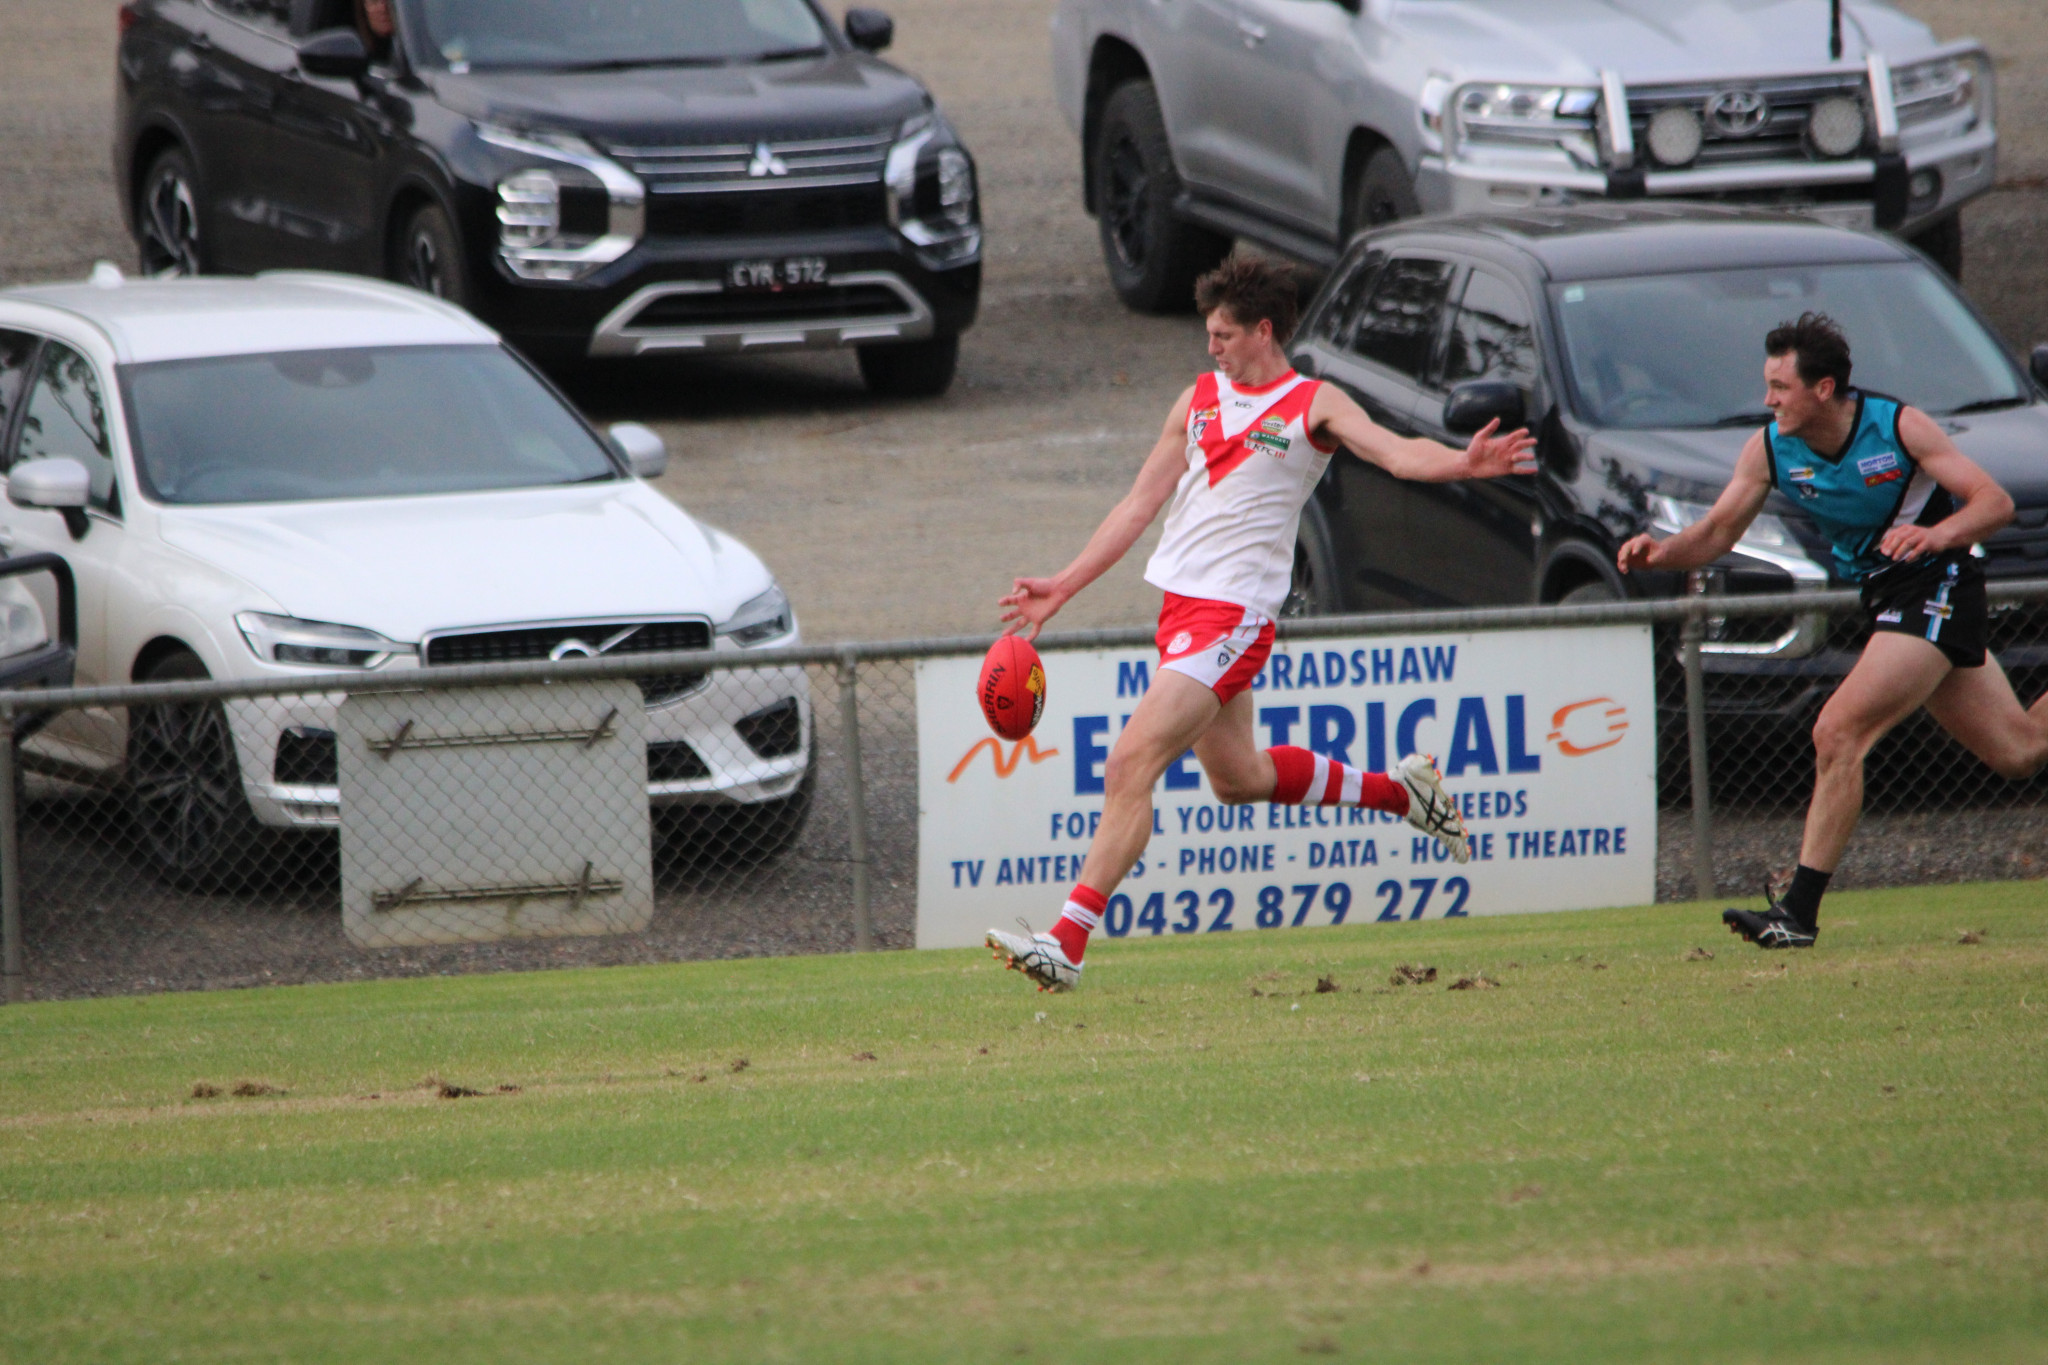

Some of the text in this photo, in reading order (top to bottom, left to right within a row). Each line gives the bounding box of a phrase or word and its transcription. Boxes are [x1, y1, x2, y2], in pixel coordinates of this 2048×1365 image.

[1073, 694, 1541, 796] ETRICAL
[1177, 803, 1255, 834] YOUR
[1268, 802, 1404, 829] ELECTRIC
[951, 859, 985, 888] TV
[995, 852, 1146, 886] ANTENS
[1179, 844, 1275, 876] PHONE
[1308, 838, 1379, 870] DATA
[1506, 826, 1627, 860] THEATRE
[1103, 876, 1470, 938] 0432 879 272
